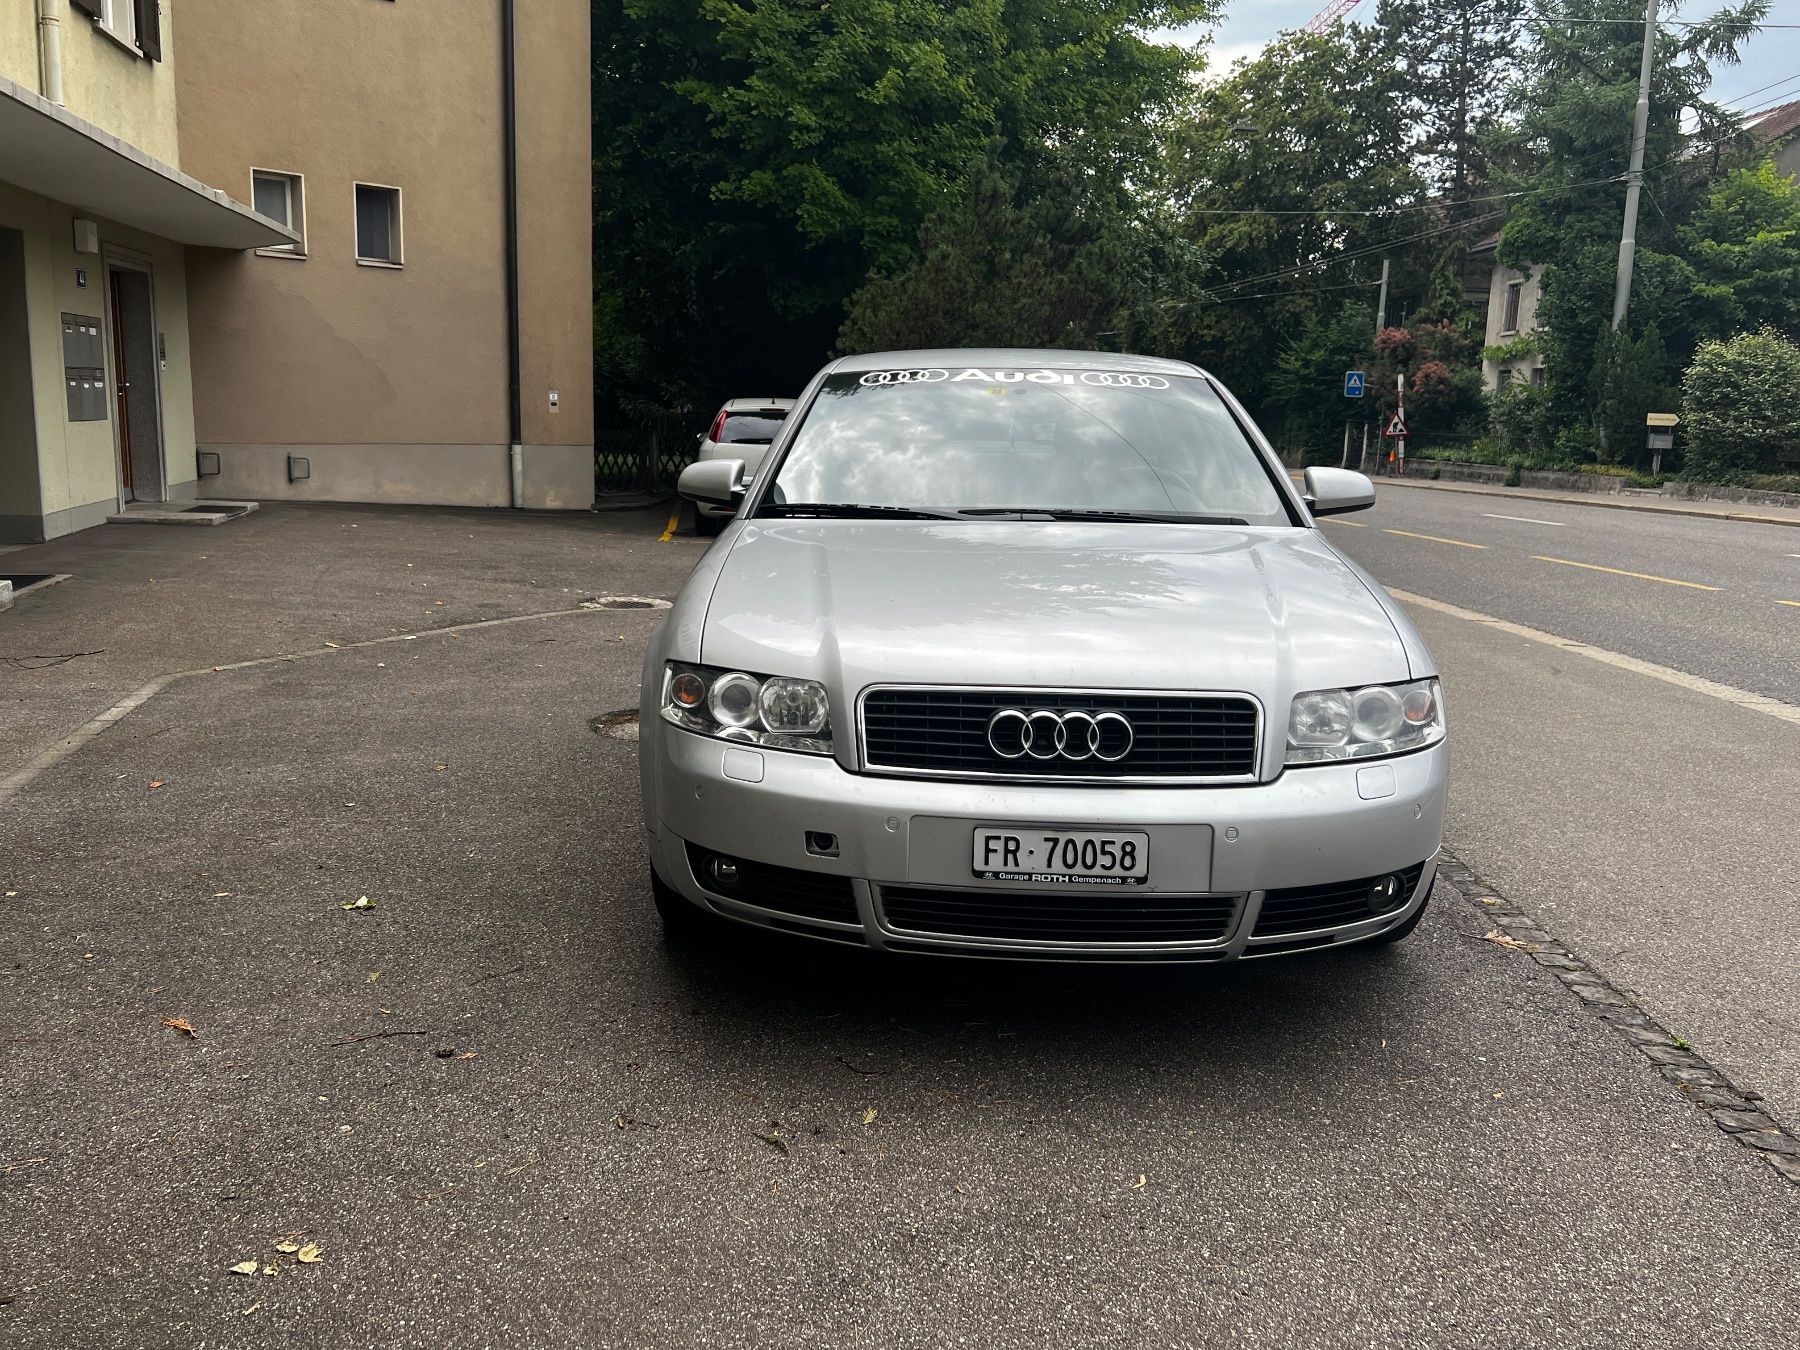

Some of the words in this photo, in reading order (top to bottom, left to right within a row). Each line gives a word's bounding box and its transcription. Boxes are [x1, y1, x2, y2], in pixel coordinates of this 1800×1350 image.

[949, 368, 1074, 385] Audi
[984, 835, 1020, 868] FR
[1043, 837, 1136, 872] 70058
[999, 872, 1029, 881] Garage
[1032, 874, 1069, 883] ROTH
[1071, 875, 1122, 884] Gempenach
